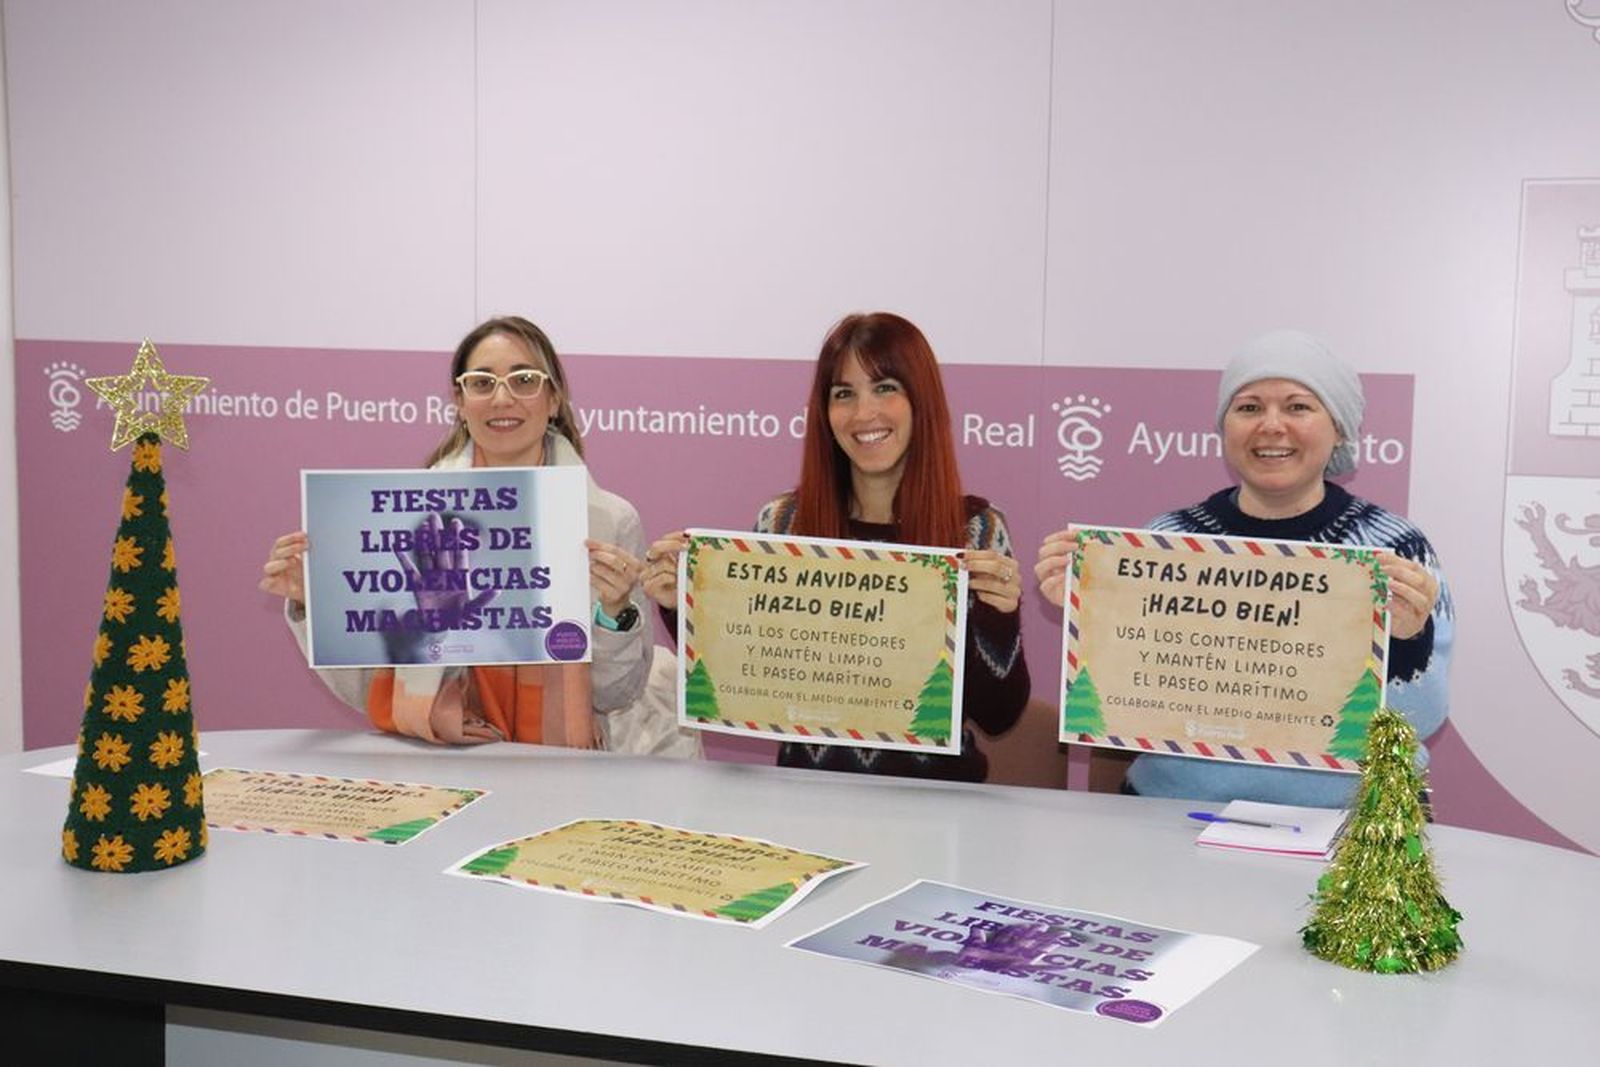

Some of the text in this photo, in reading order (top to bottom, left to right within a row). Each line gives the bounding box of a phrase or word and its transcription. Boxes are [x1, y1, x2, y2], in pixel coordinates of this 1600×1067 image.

[285, 389, 319, 419] de
[327, 392, 418, 423] Puerto
[578, 404, 780, 438] yuntamiento
[963, 413, 1035, 447] Real
[371, 487, 518, 513] FIESTAS
[489, 527, 532, 551] DE
[343, 566, 551, 593] VIOLENCIAS
[727, 562, 909, 594] ESTAS NAVIDADES
[1117, 557, 1329, 594] ESTAS NAVIDADES
[748, 593, 885, 622] ¡HAZLO BIEN!
[1142, 593, 1300, 627] ¡HAZLO BIEN!
[726, 623, 906, 650] USA LOS CONTENEDORES
[1116, 626, 1325, 658] USA LOS CONTENEDORES
[746, 644, 883, 668] Y MANTÉN LIMPIO
[1139, 651, 1298, 678] Y MANTÉN LIMPIO
[742, 663, 757, 677] EL
[763, 667, 806, 681] PASEO
[1133, 672, 1308, 702] EL PASEO MARÍTIMO
[1106, 695, 1316, 727] COLABORA CON EL MEDIO AMBIENTE
[601, 825, 791, 861] ESTAS NAVIDADES
[974, 900, 1160, 943] FIESTAS
[1088, 941, 1155, 962] DE
